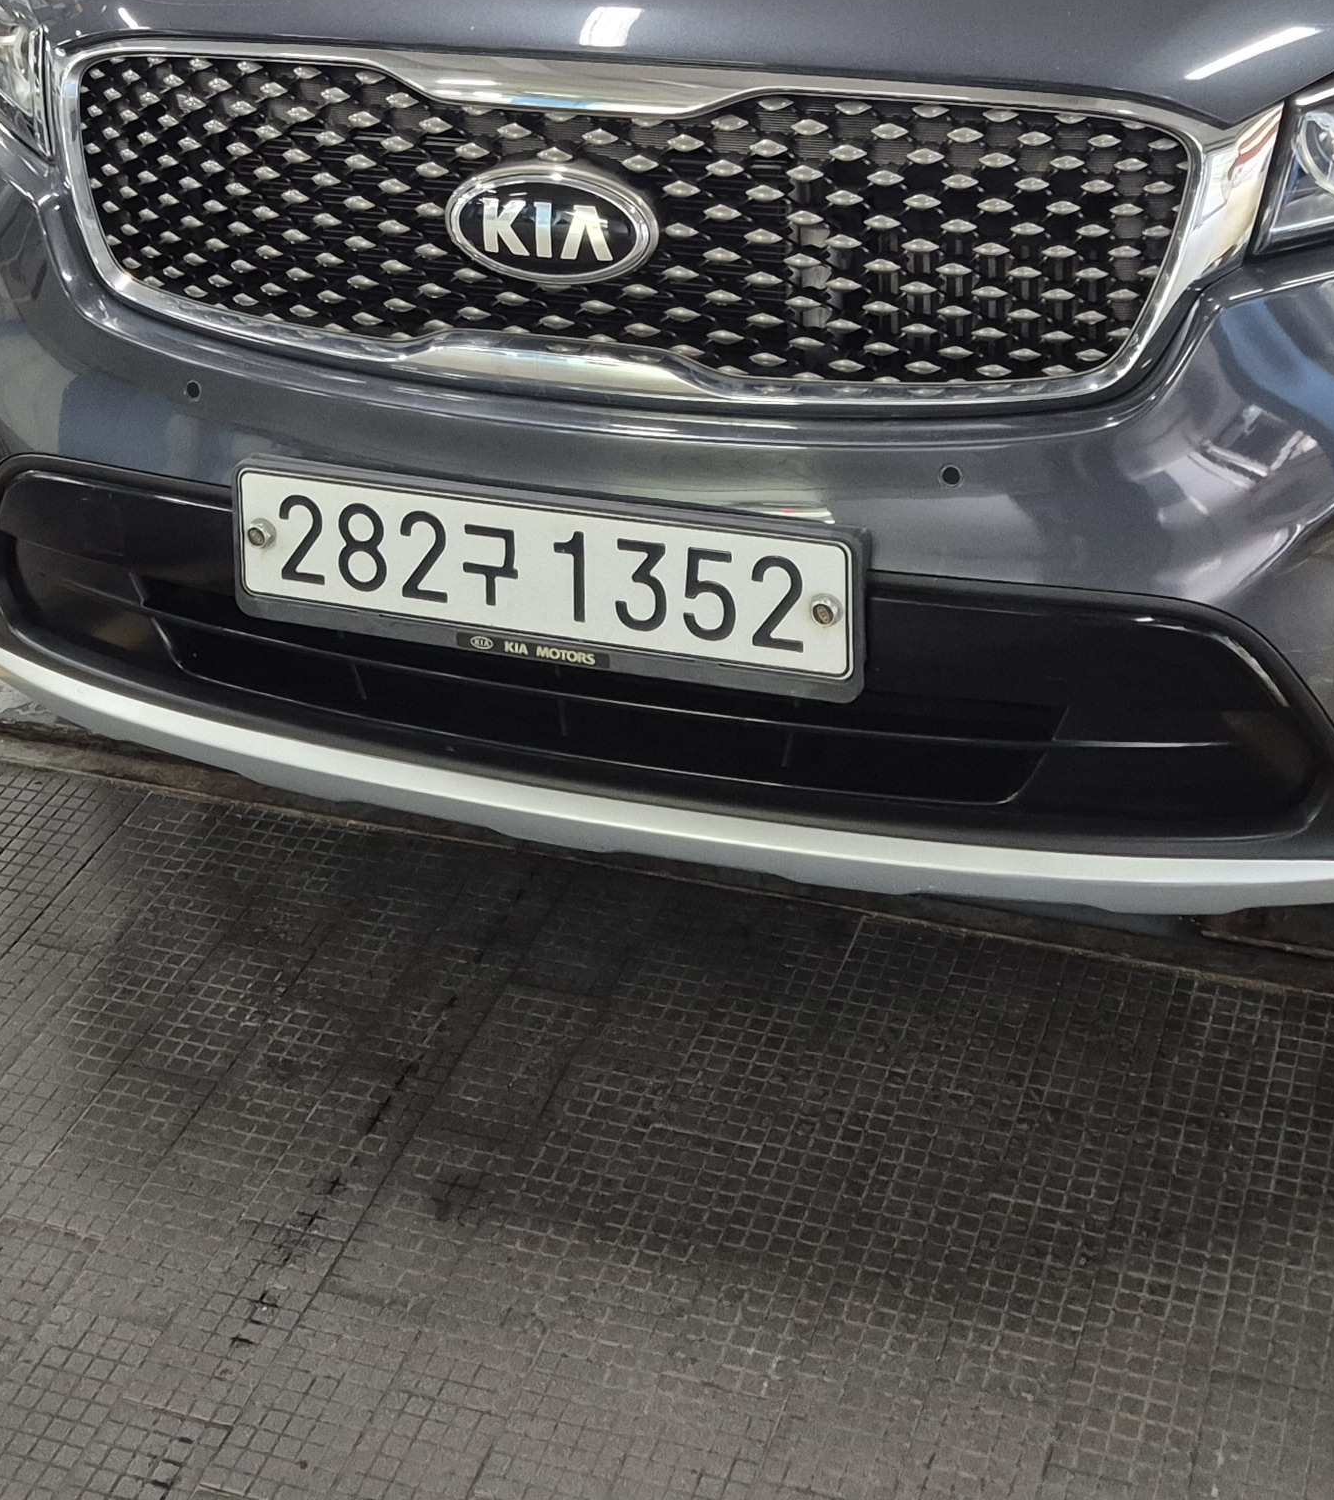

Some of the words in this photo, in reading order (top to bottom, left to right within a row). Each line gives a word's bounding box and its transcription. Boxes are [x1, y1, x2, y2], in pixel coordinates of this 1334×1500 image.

[478, 196, 614, 262] KIA
[278, 494, 519, 607] 282구
[553, 530, 805, 653] 1352
[504, 641, 529, 656] KIA
[536, 645, 596, 666] MOTORS
